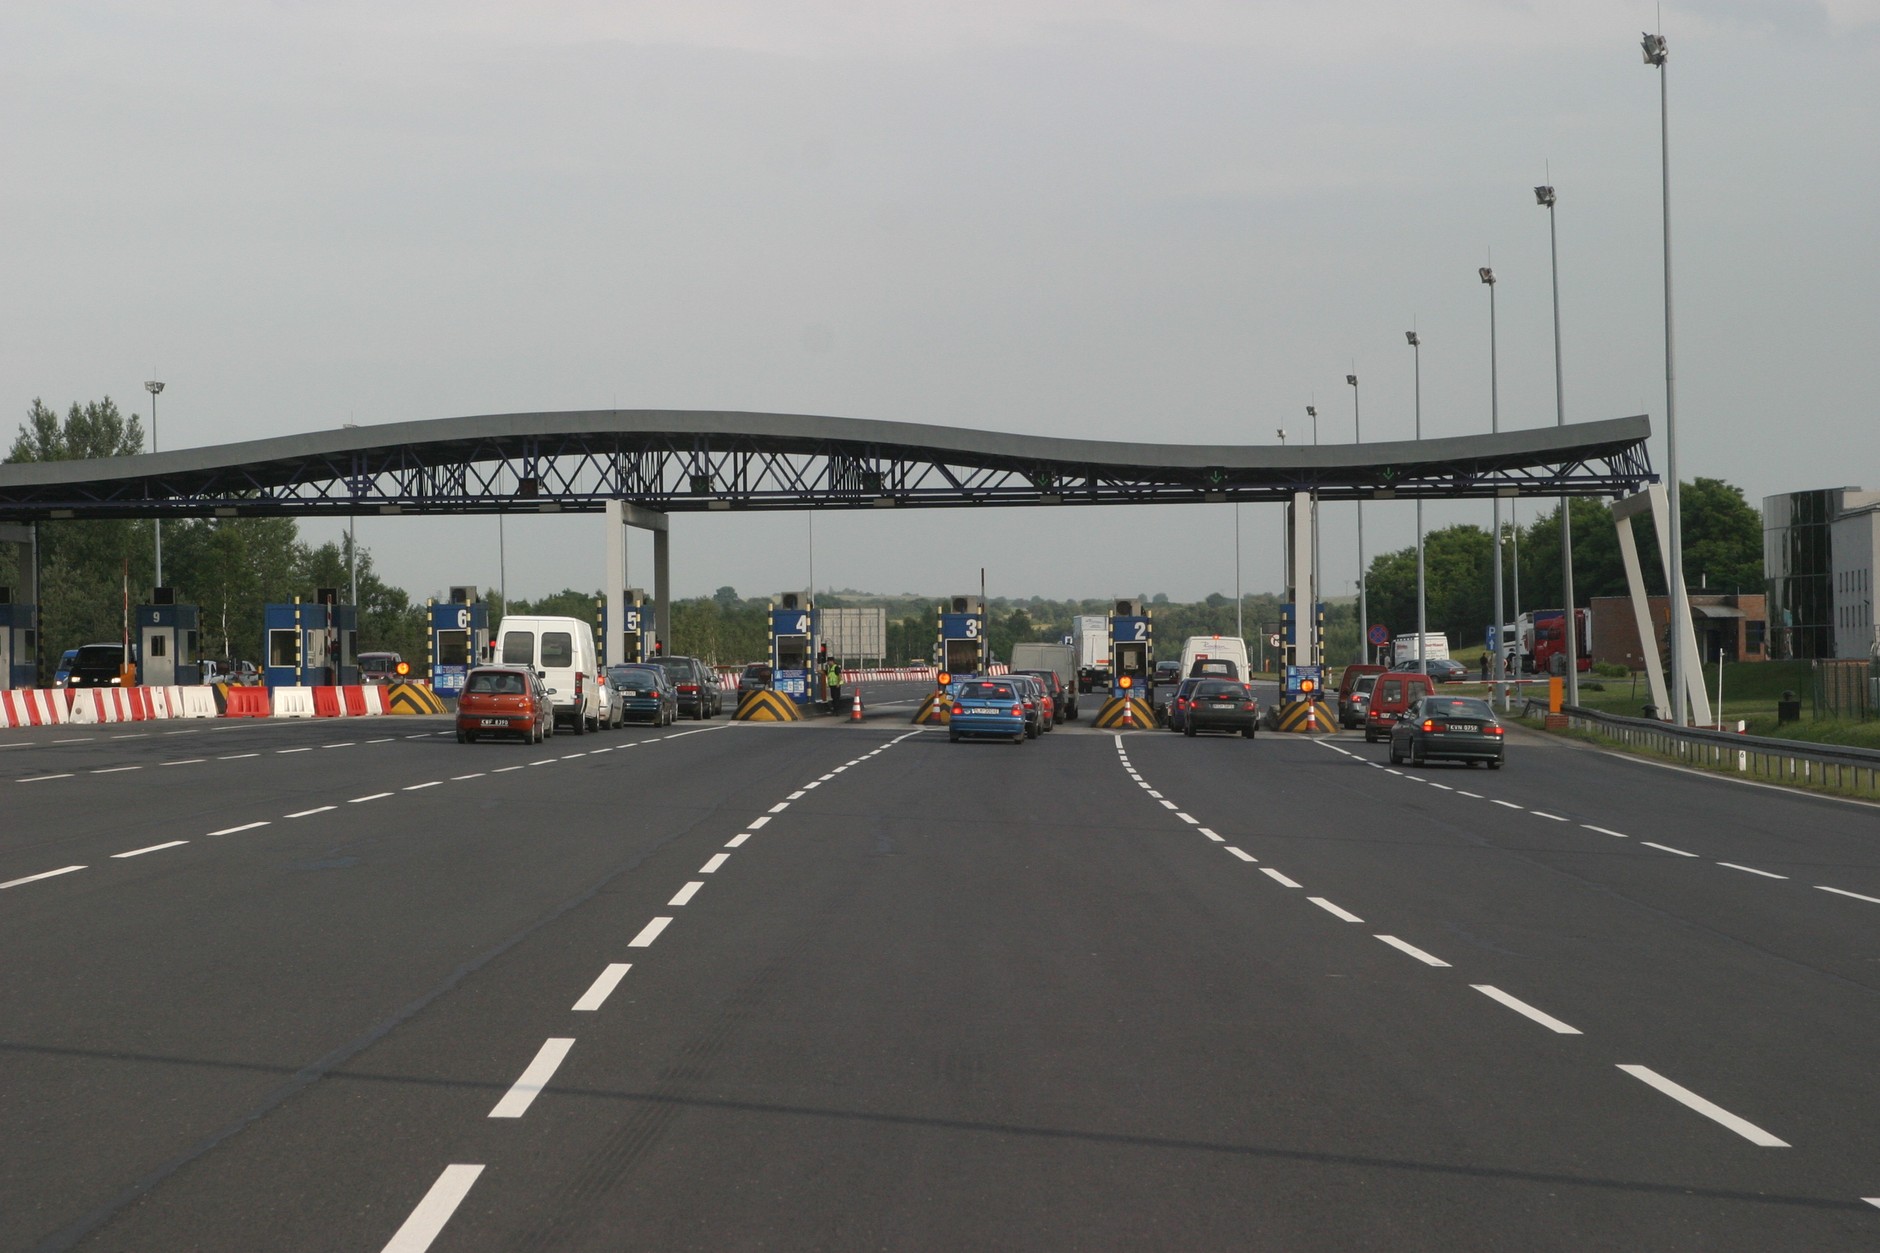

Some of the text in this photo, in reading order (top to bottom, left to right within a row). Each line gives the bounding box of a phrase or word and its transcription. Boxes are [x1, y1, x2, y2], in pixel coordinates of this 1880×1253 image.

[153, 612, 160, 622] 9
[458, 609, 467, 628] 6
[627, 612, 637, 630] 5
[796, 615, 807, 633] 4
[966, 619, 977, 638] 3
[1134, 622, 1146, 640] 2
[1489, 627, 1496, 637] P
